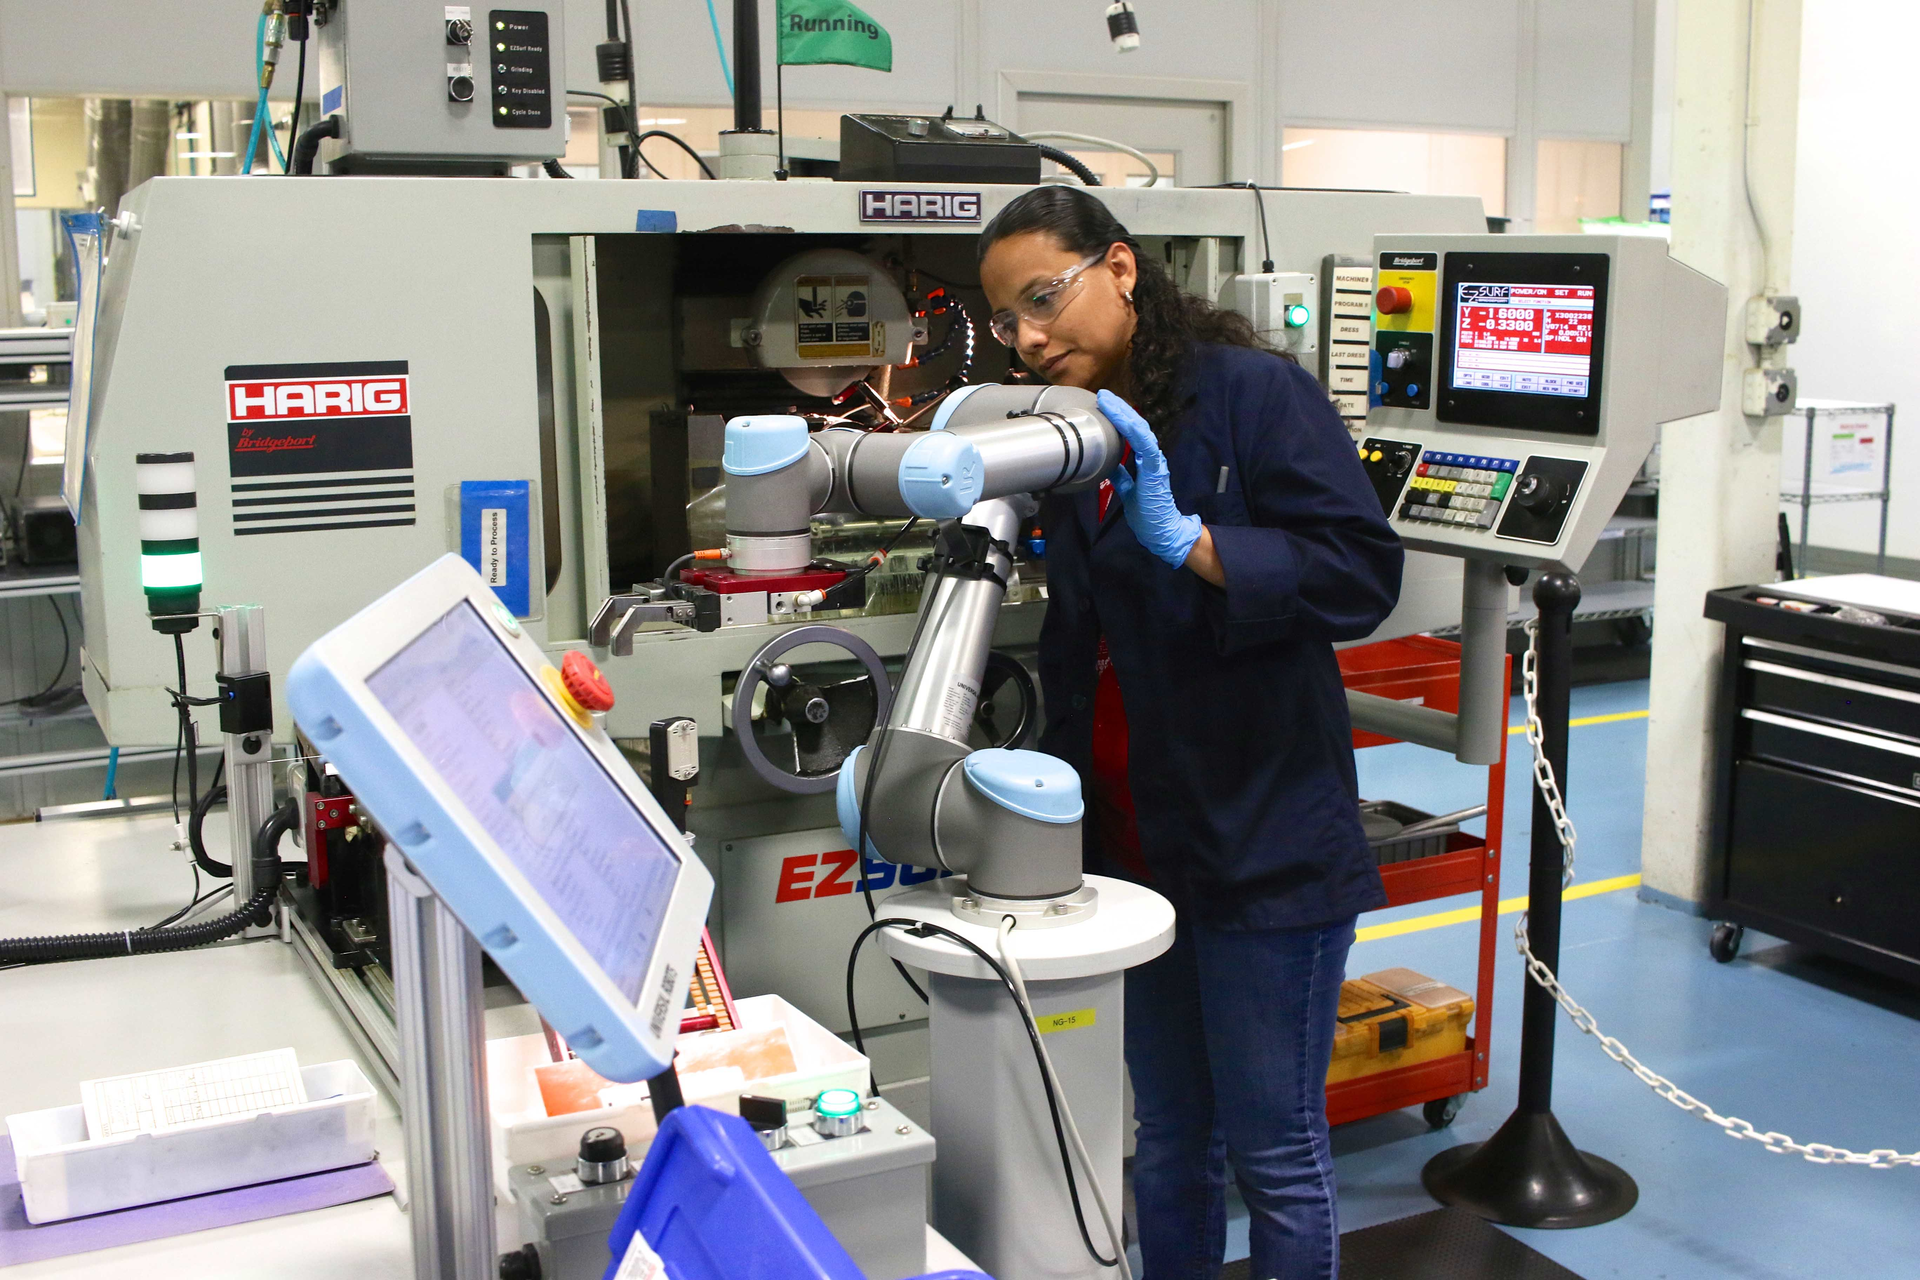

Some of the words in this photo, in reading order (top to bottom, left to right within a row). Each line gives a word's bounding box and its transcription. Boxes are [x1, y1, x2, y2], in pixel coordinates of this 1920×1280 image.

[790, 14, 879, 40] Running
[510, 66, 533, 74] Grinding
[865, 194, 978, 218] HARIG
[1510, 288, 1548, 296] POWER/ON
[1463, 307, 1471, 317] Y
[1479, 308, 1534, 320] -1.6000
[1462, 318, 1471, 328] Z
[1479, 319, 1534, 331] -0.3300
[234, 381, 402, 417] HARIG
[241, 428, 255, 437] by
[234, 434, 317, 453] Bridgeport
[491, 548, 498, 556] to
[490, 558, 499, 584] Ready
[1052, 1016, 1076, 1026] NG-15
